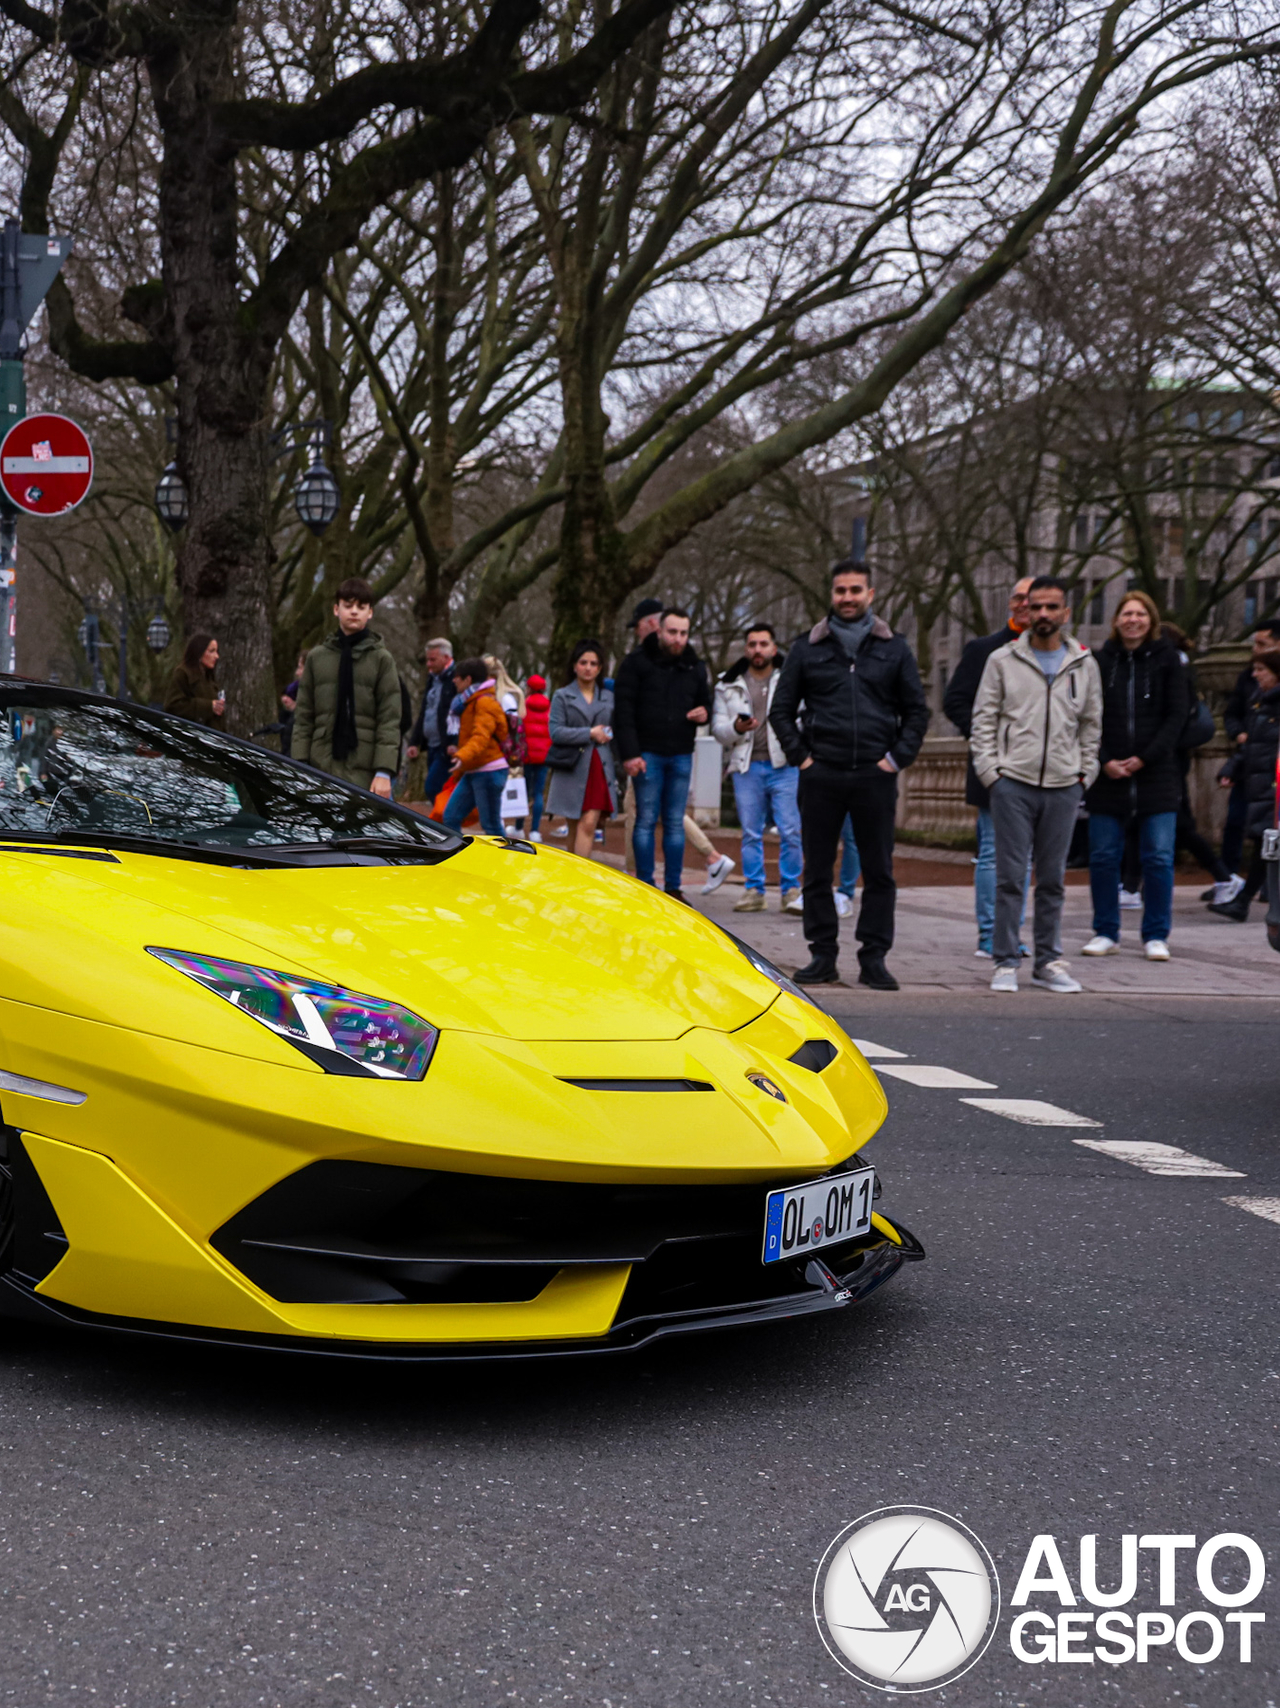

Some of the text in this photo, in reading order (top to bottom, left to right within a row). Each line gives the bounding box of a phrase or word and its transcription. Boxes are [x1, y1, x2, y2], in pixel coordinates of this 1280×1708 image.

[782, 1177, 870, 1251] OL OM 1
[769, 1234, 777, 1250] D
